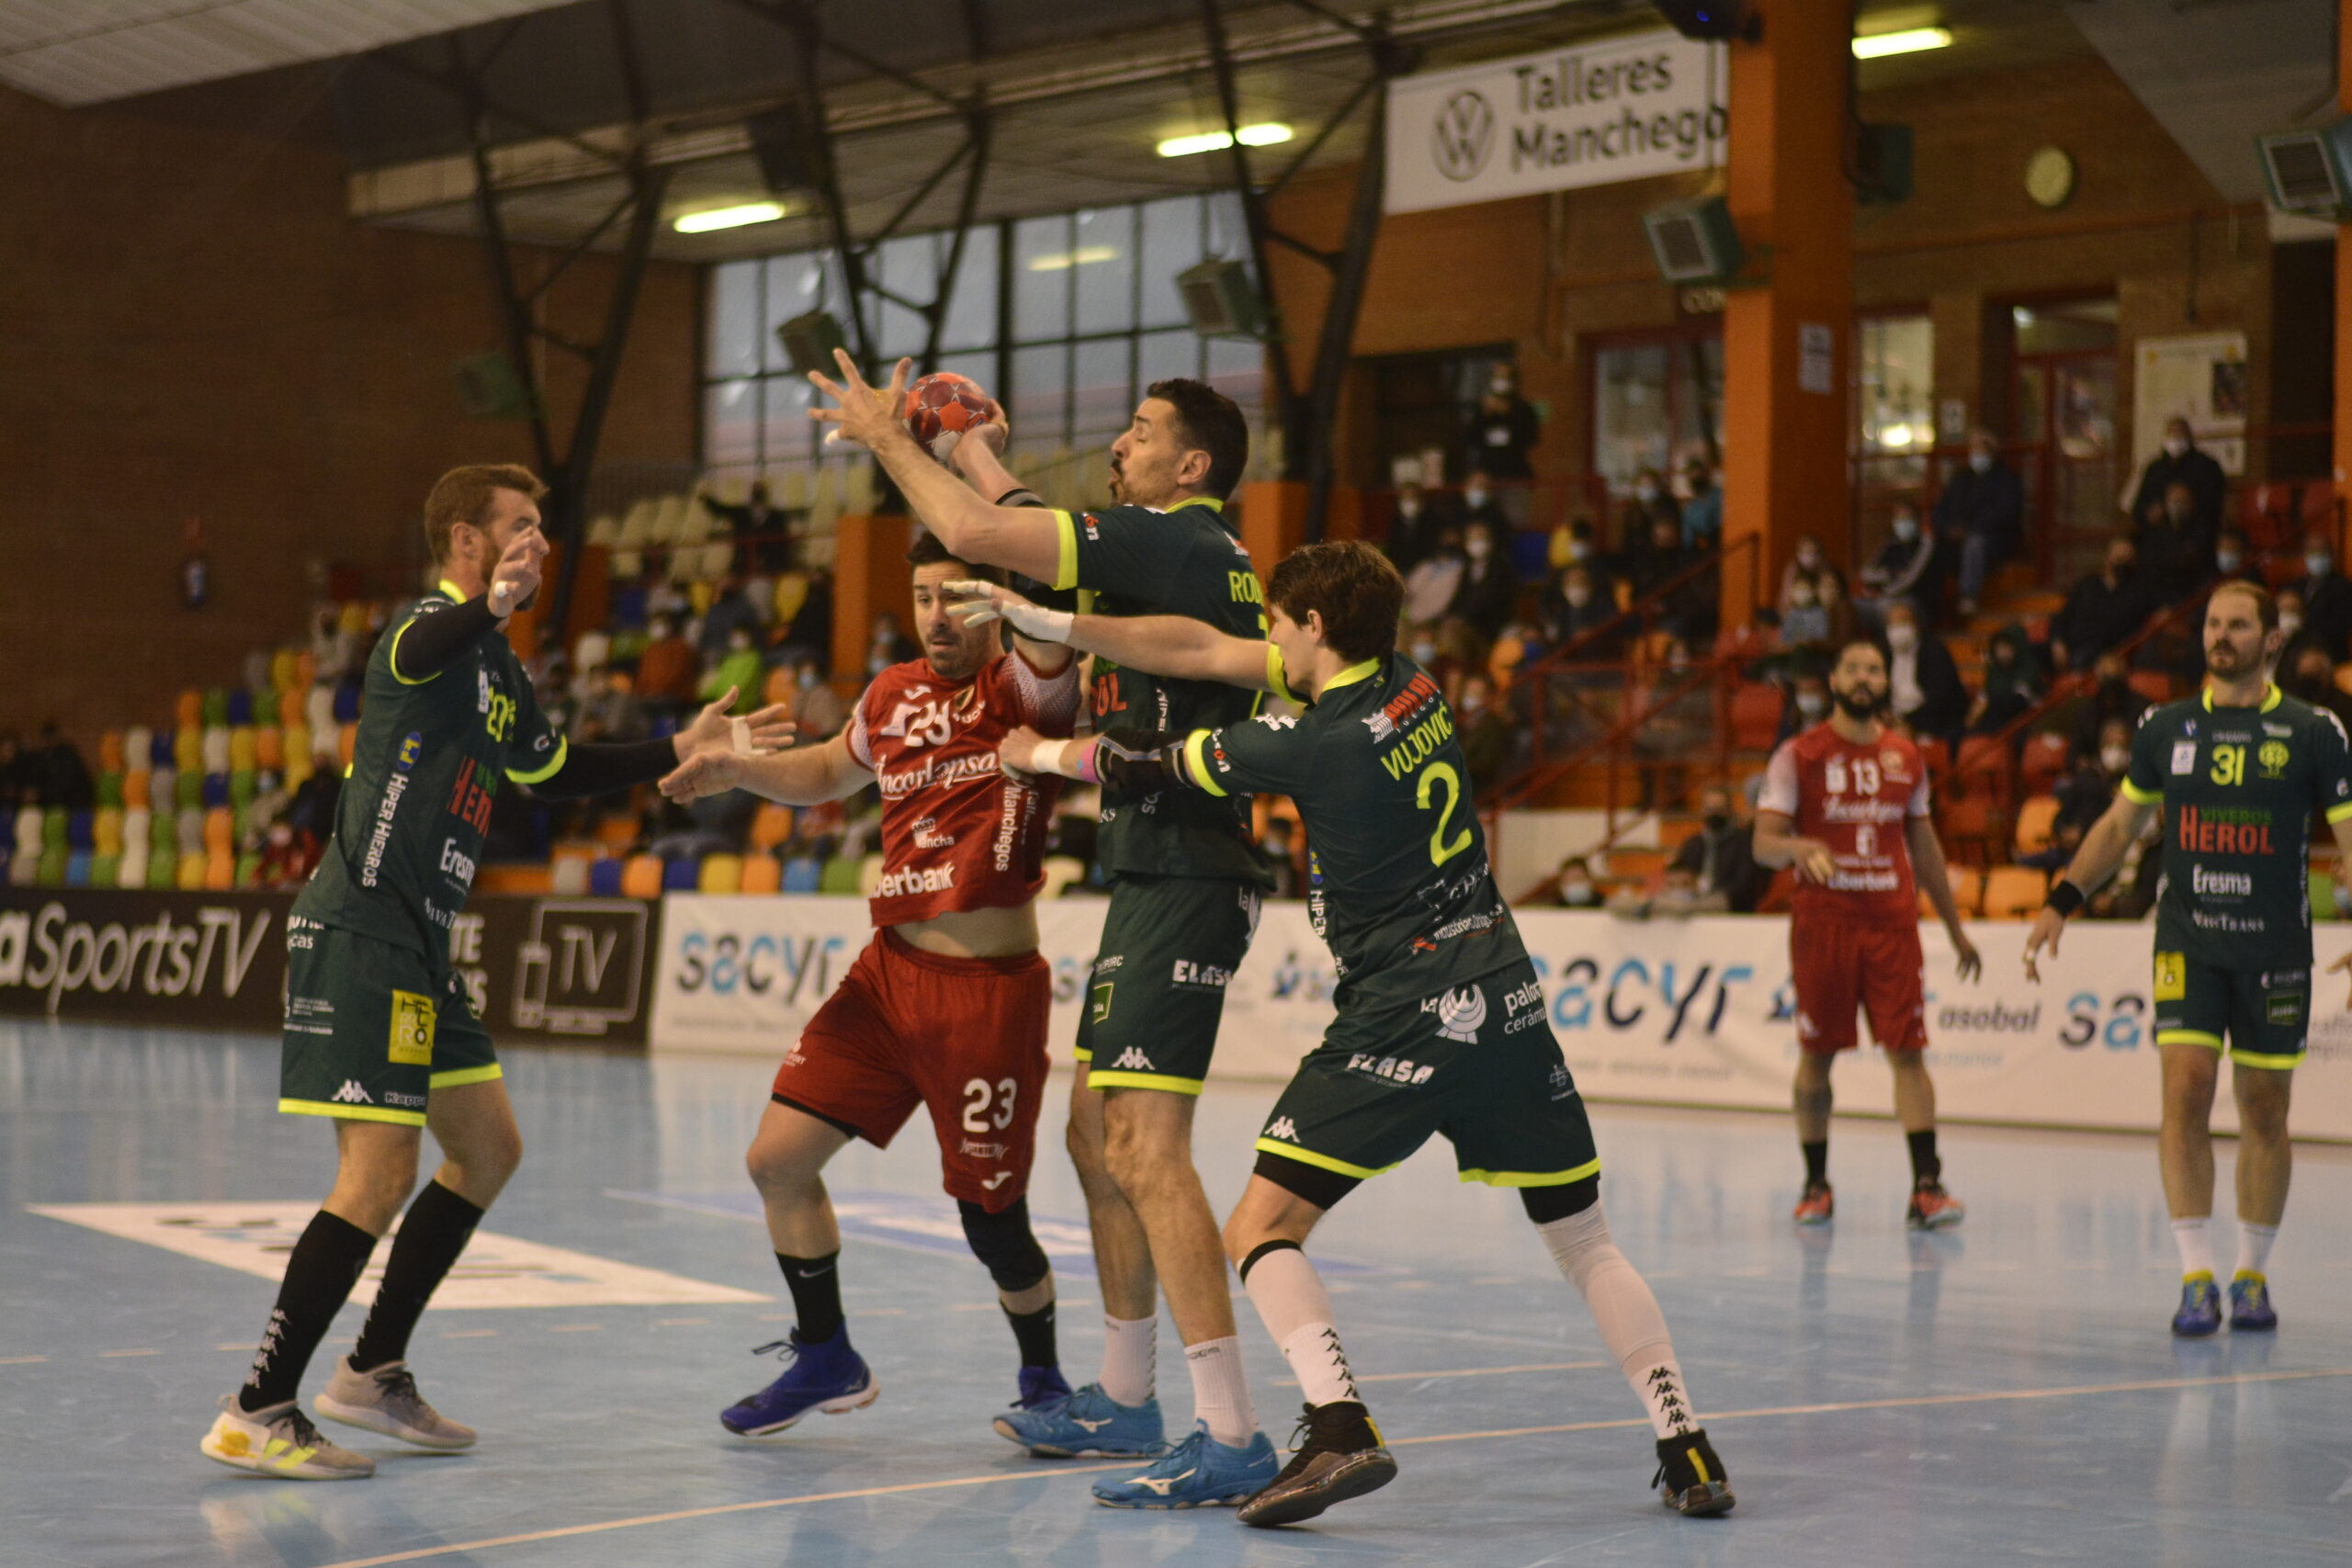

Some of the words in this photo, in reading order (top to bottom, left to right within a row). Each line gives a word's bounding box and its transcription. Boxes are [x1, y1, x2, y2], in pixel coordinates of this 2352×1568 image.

[1509, 51, 1674, 114] Talleres
[1380, 701, 1454, 781] VUJOVIĆ
[2210, 743, 2246, 786] 31
[378, 773, 410, 821] HIPER
[1851, 757, 1881, 796] 13
[993, 785, 1023, 873] Manchegos
[1416, 761, 1473, 868] 2
[2179, 804, 2275, 855] HEROL
[362, 820, 393, 887] HIERROS
[2192, 863, 2251, 897] Eresma
[1309, 888, 1328, 936] HIPER
[559, 924, 617, 994] TV
[677, 932, 845, 1007] sacyr
[1939, 997, 2041, 1034] asobal
[1347, 1054, 1434, 1084] ELASA
[962, 1077, 1018, 1134] 23
